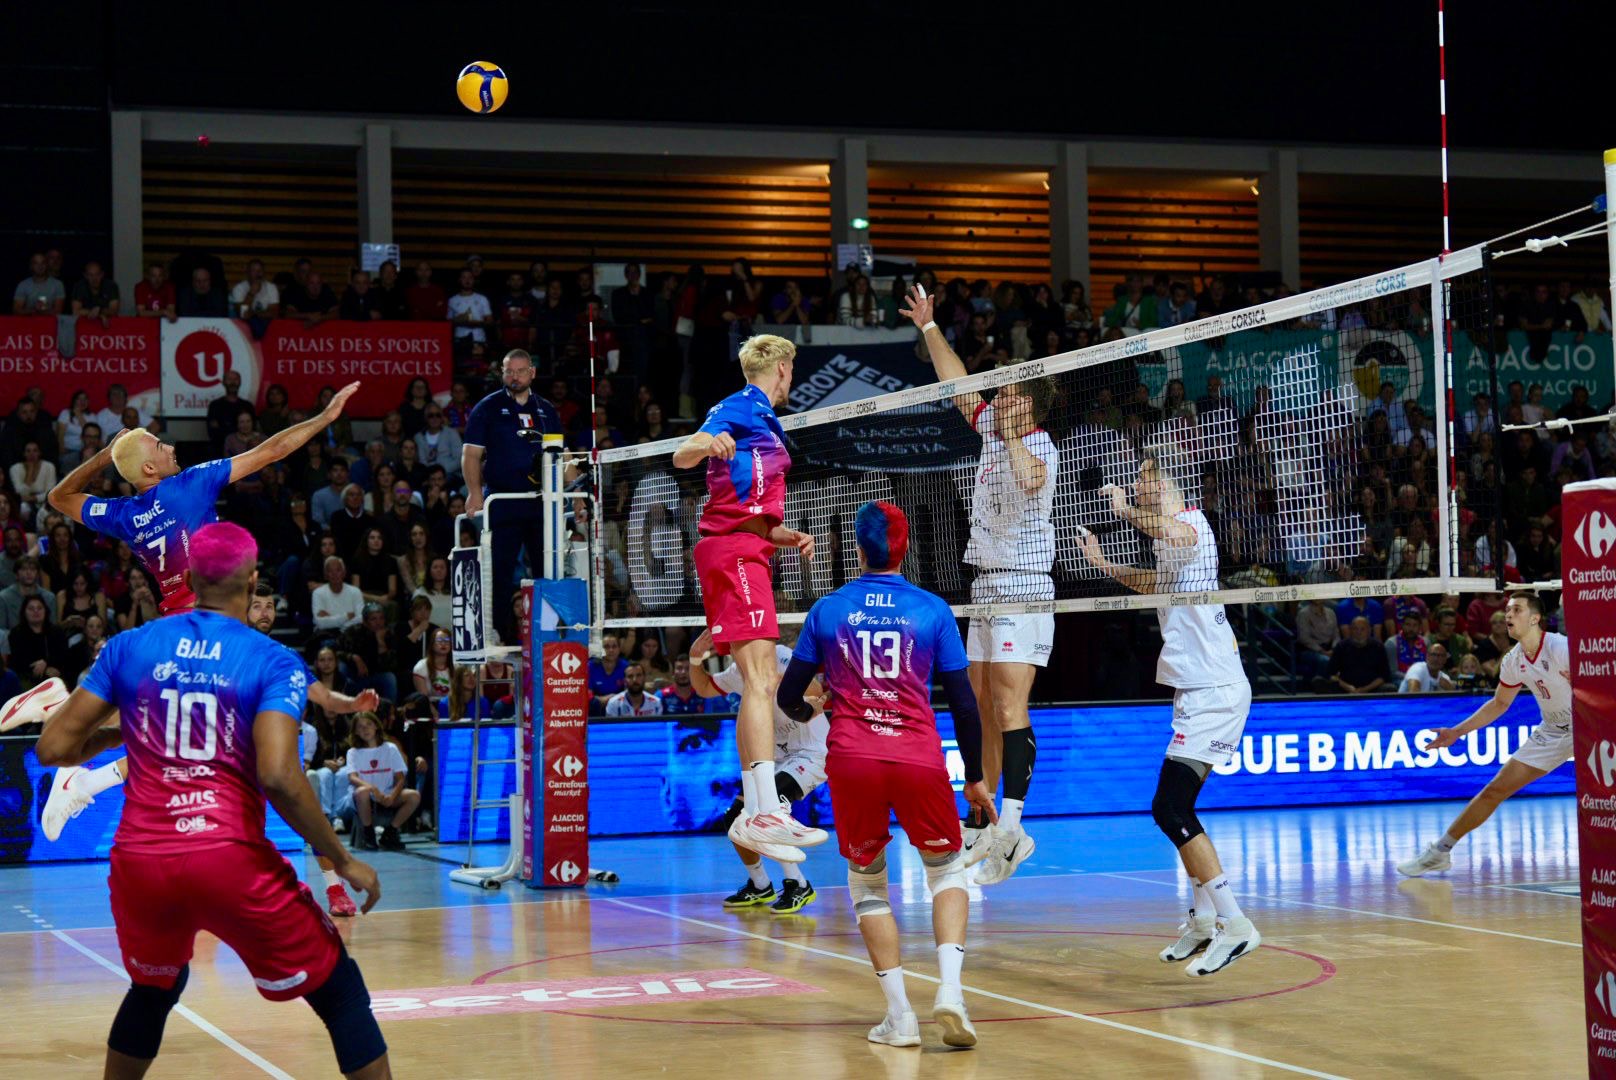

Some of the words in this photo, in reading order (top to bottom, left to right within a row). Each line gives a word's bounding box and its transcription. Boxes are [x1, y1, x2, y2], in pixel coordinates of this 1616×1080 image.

[1375, 272, 1407, 294] CORSE
[1231, 309, 1266, 330] CORSICA
[79, 335, 147, 350] SPORTS
[278, 337, 335, 352] PALAIS
[340, 338, 372, 353] DES
[378, 339, 440, 354] SPORTS
[1125, 338, 1148, 356] CORSE
[0, 358, 34, 373] DES
[40, 357, 148, 373] SPECTACLES
[277, 359, 297, 374] ET
[303, 360, 336, 374] DES
[340, 360, 442, 376] SPECTACLES
[1018, 363, 1045, 379] CORSICA
[786, 363, 845, 412] LEROY
[939, 384, 956, 397] CORSE
[146, 535, 166, 572] 7
[1255, 590, 1274, 601] Gamm
[1276, 590, 1289, 600] vert
[1349, 583, 1371, 595] Gamm
[1373, 583, 1388, 594] vert
[865, 593, 895, 608] GILL
[1170, 595, 1187, 606] Gamm
[749, 610, 765, 628] 17
[176, 637, 223, 660] BALA
[856, 630, 901, 679] 13
[1578, 661, 1610, 676] Albert
[547, 677, 585, 686] Carrefour
[552, 686, 580, 694] market
[551, 709, 583, 717] AJACCIO
[160, 688, 218, 761] 10
[549, 719, 573, 728] Albert
[573, 719, 585, 728] 1er
[1308, 729, 1338, 772] B
[1344, 724, 1541, 771] MASCULI
[548, 780, 587, 788] Carrefour
[165, 790, 216, 808] AVIS
[554, 789, 582, 797] market
[552, 814, 584, 822] AJACCIO
[550, 825, 574, 833] Albert
[574, 825, 586, 833] 1er
[371, 976, 783, 1013] Betclic
